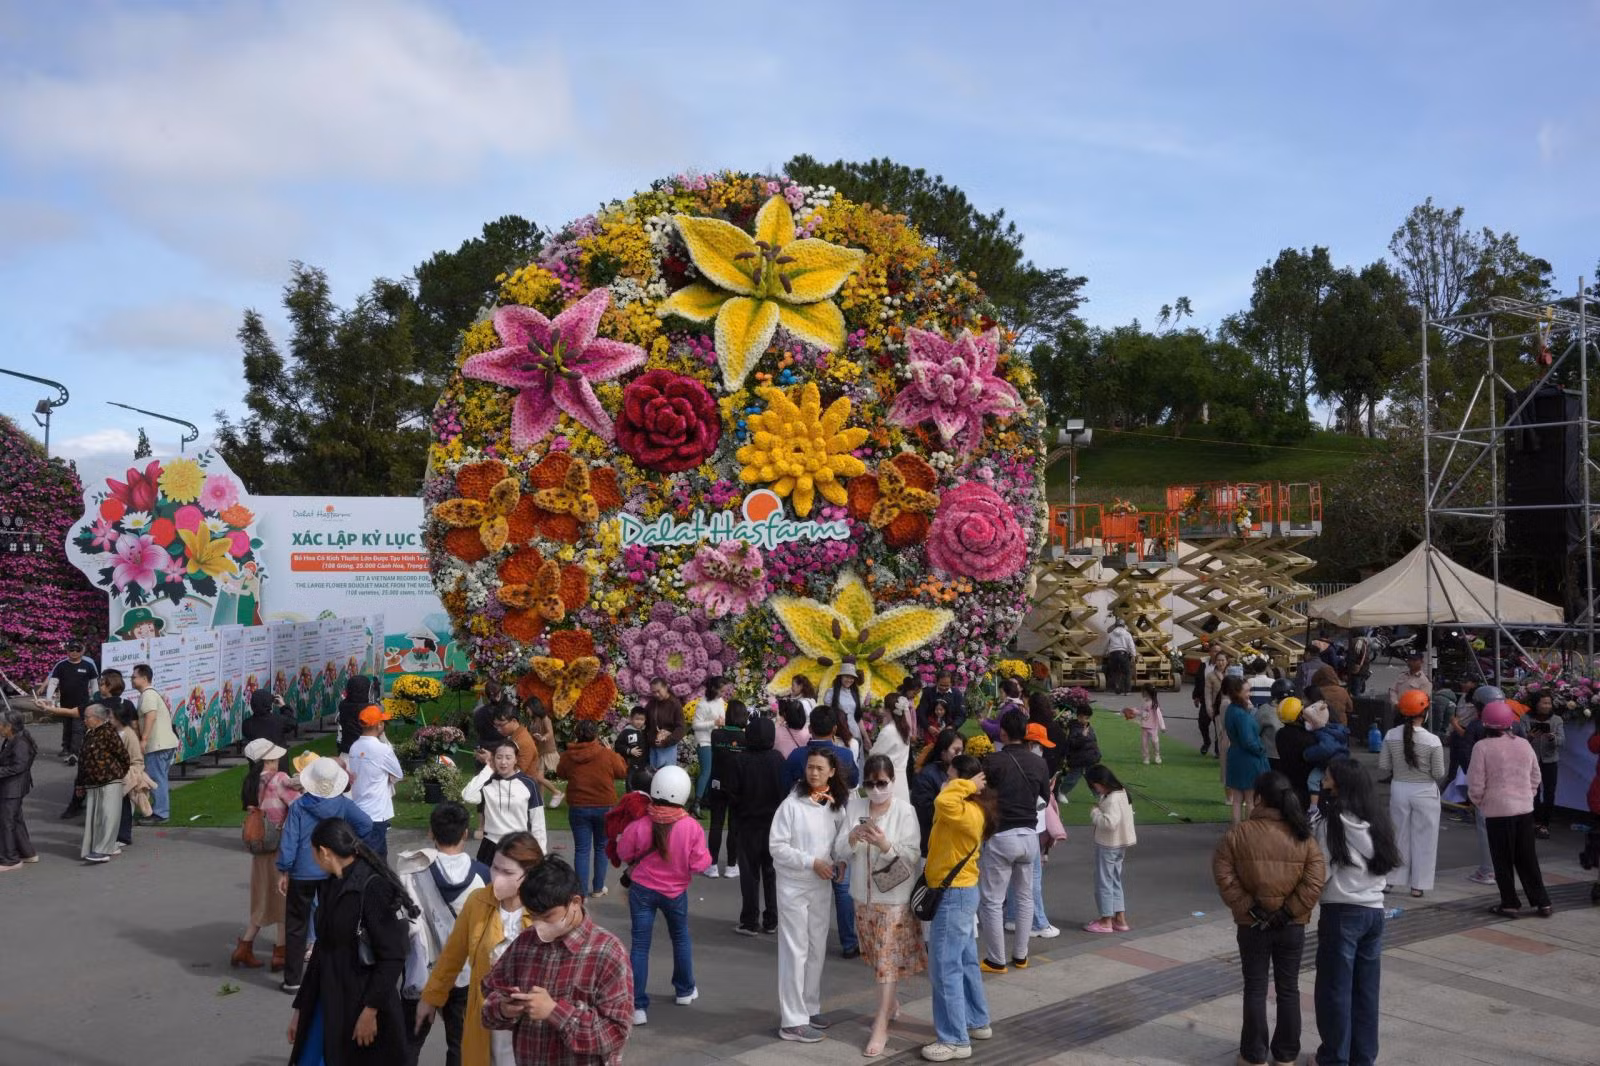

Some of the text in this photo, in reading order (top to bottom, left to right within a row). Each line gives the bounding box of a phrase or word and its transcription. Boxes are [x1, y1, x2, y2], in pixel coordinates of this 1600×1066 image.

[292, 509, 314, 518] Dalat
[292, 529, 323, 546] XÁC
[327, 530, 358, 550] LẬP
[361, 529, 382, 546] KỶ
[385, 533, 417, 550] LỤC
[621, 511, 847, 547] Dalat Hasfarm
